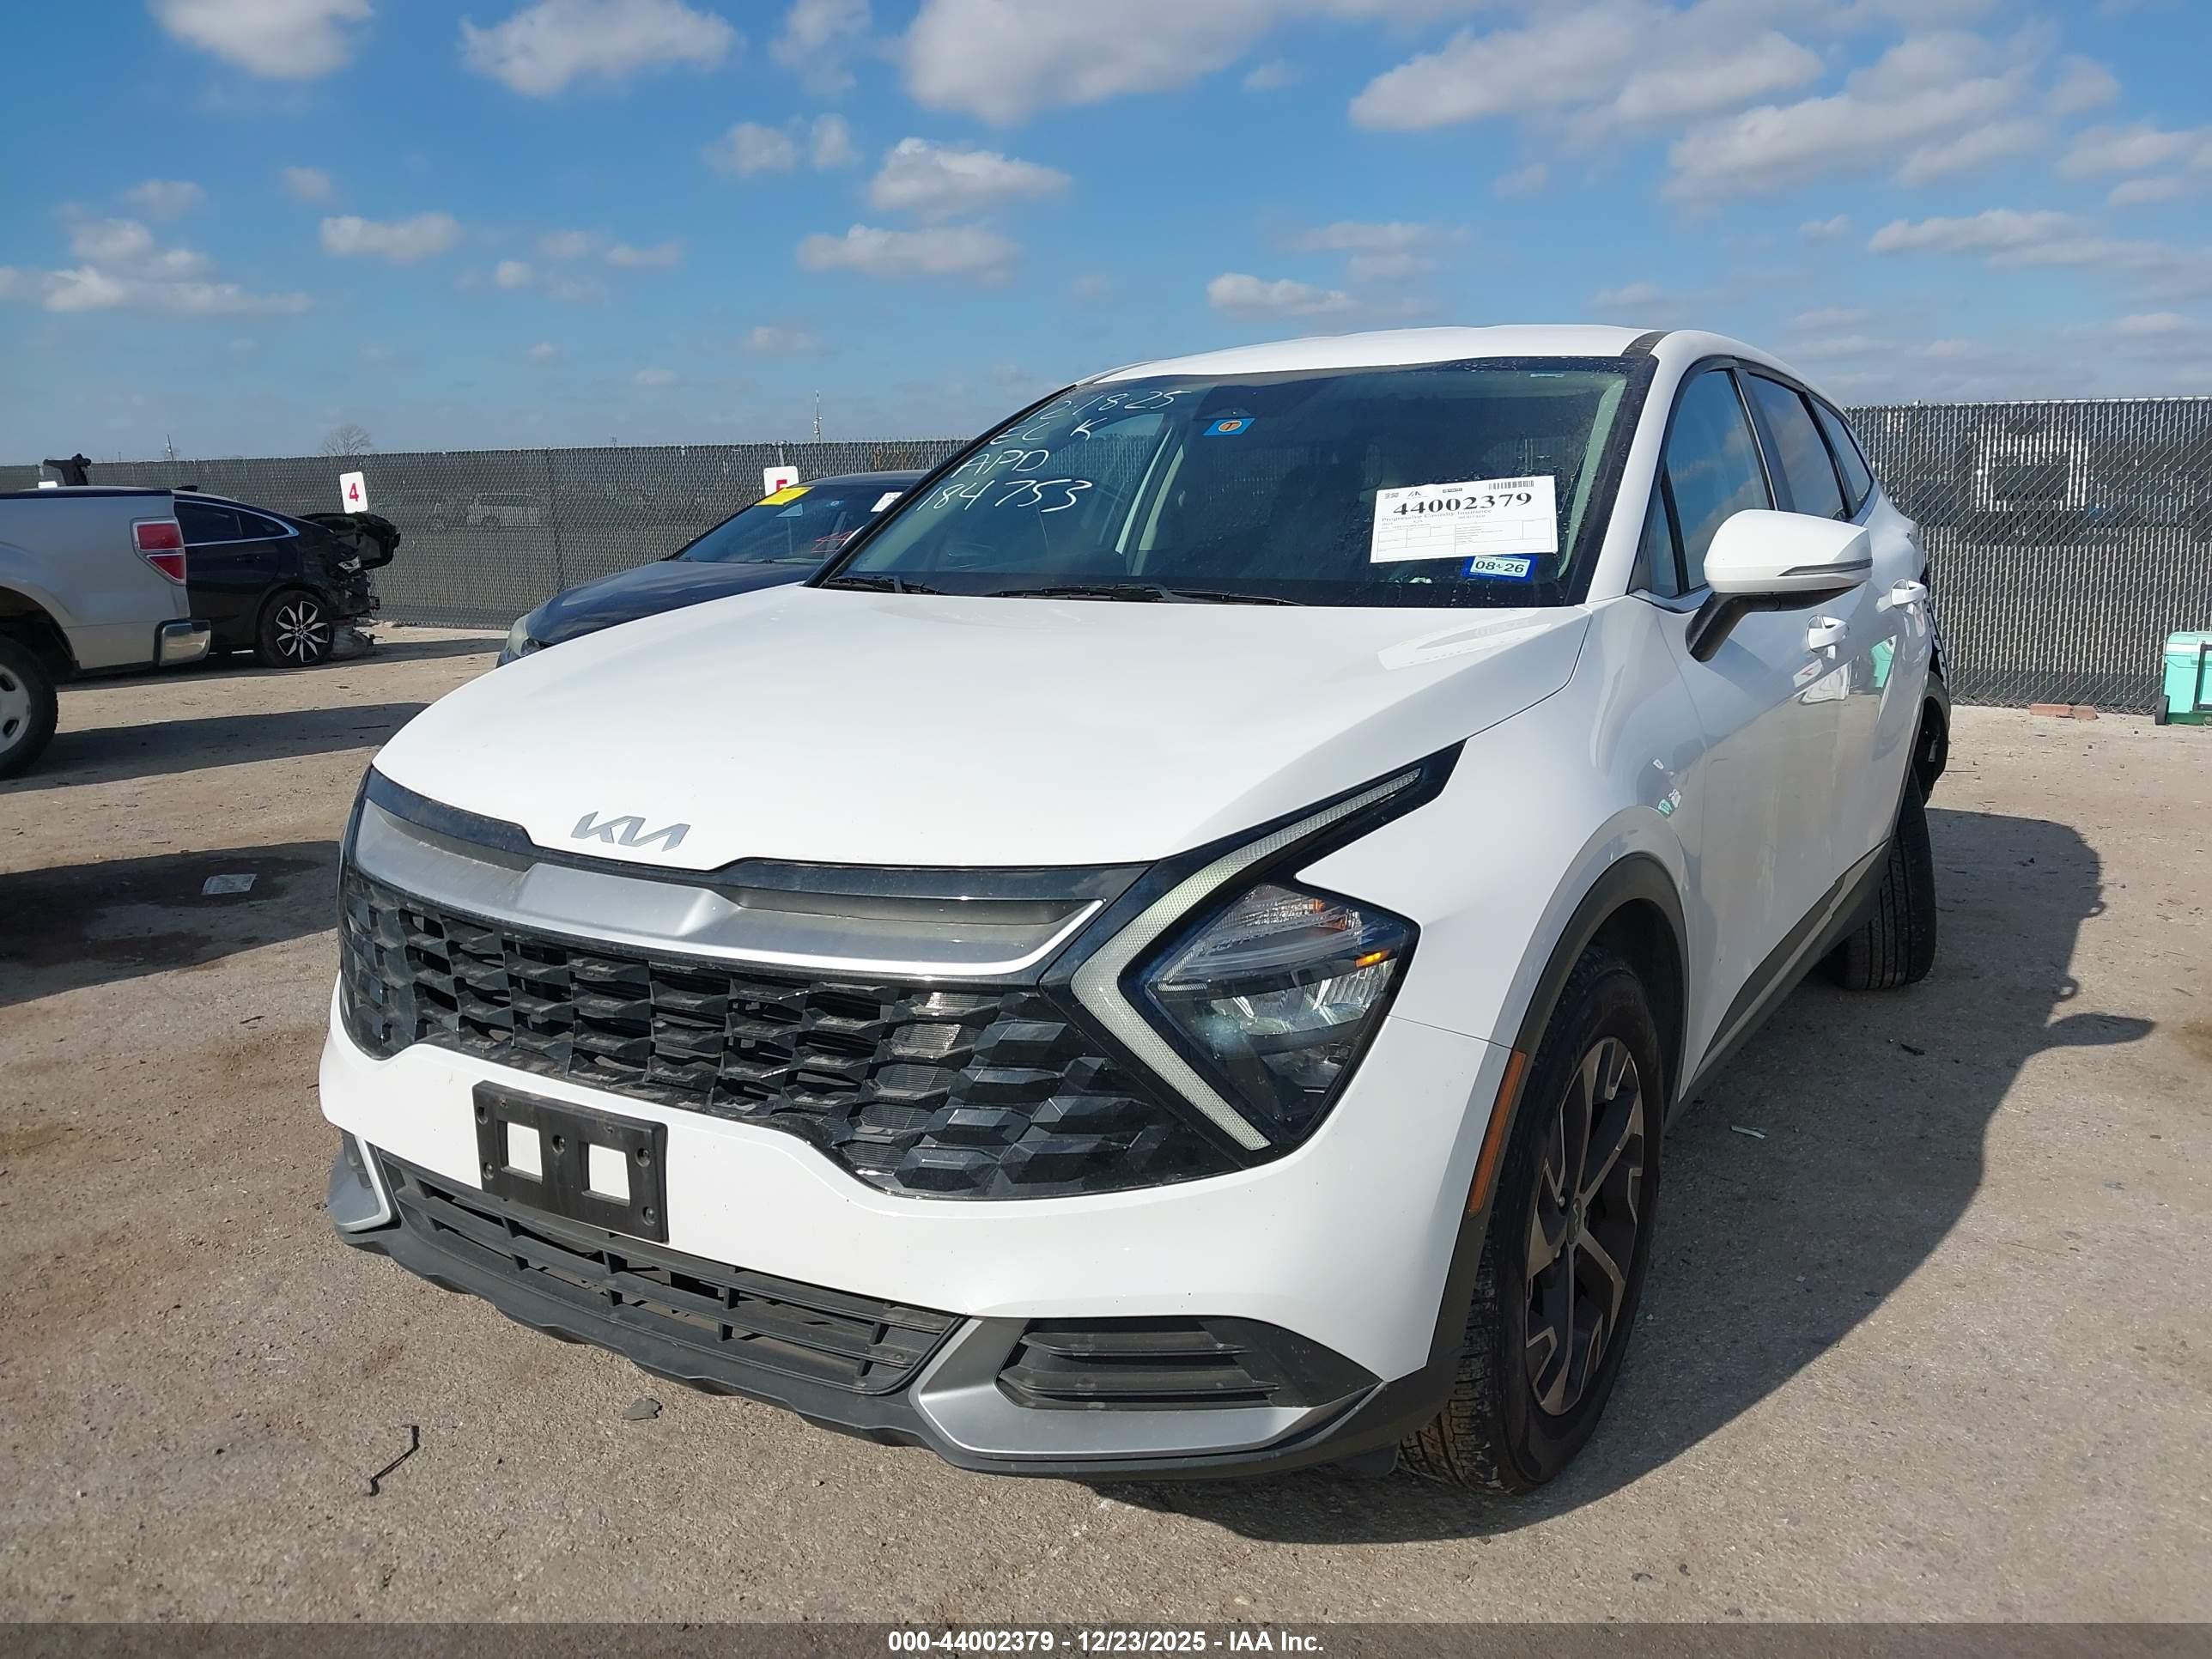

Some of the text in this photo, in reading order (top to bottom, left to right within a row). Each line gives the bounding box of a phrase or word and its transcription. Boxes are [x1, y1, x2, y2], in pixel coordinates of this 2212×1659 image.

[1070, 416, 1108, 441] K
[950, 449, 1049, 479] APD
[349, 483, 359, 501] 4
[1393, 492, 1533, 515] 44002379
[570, 811, 691, 852] KIA
